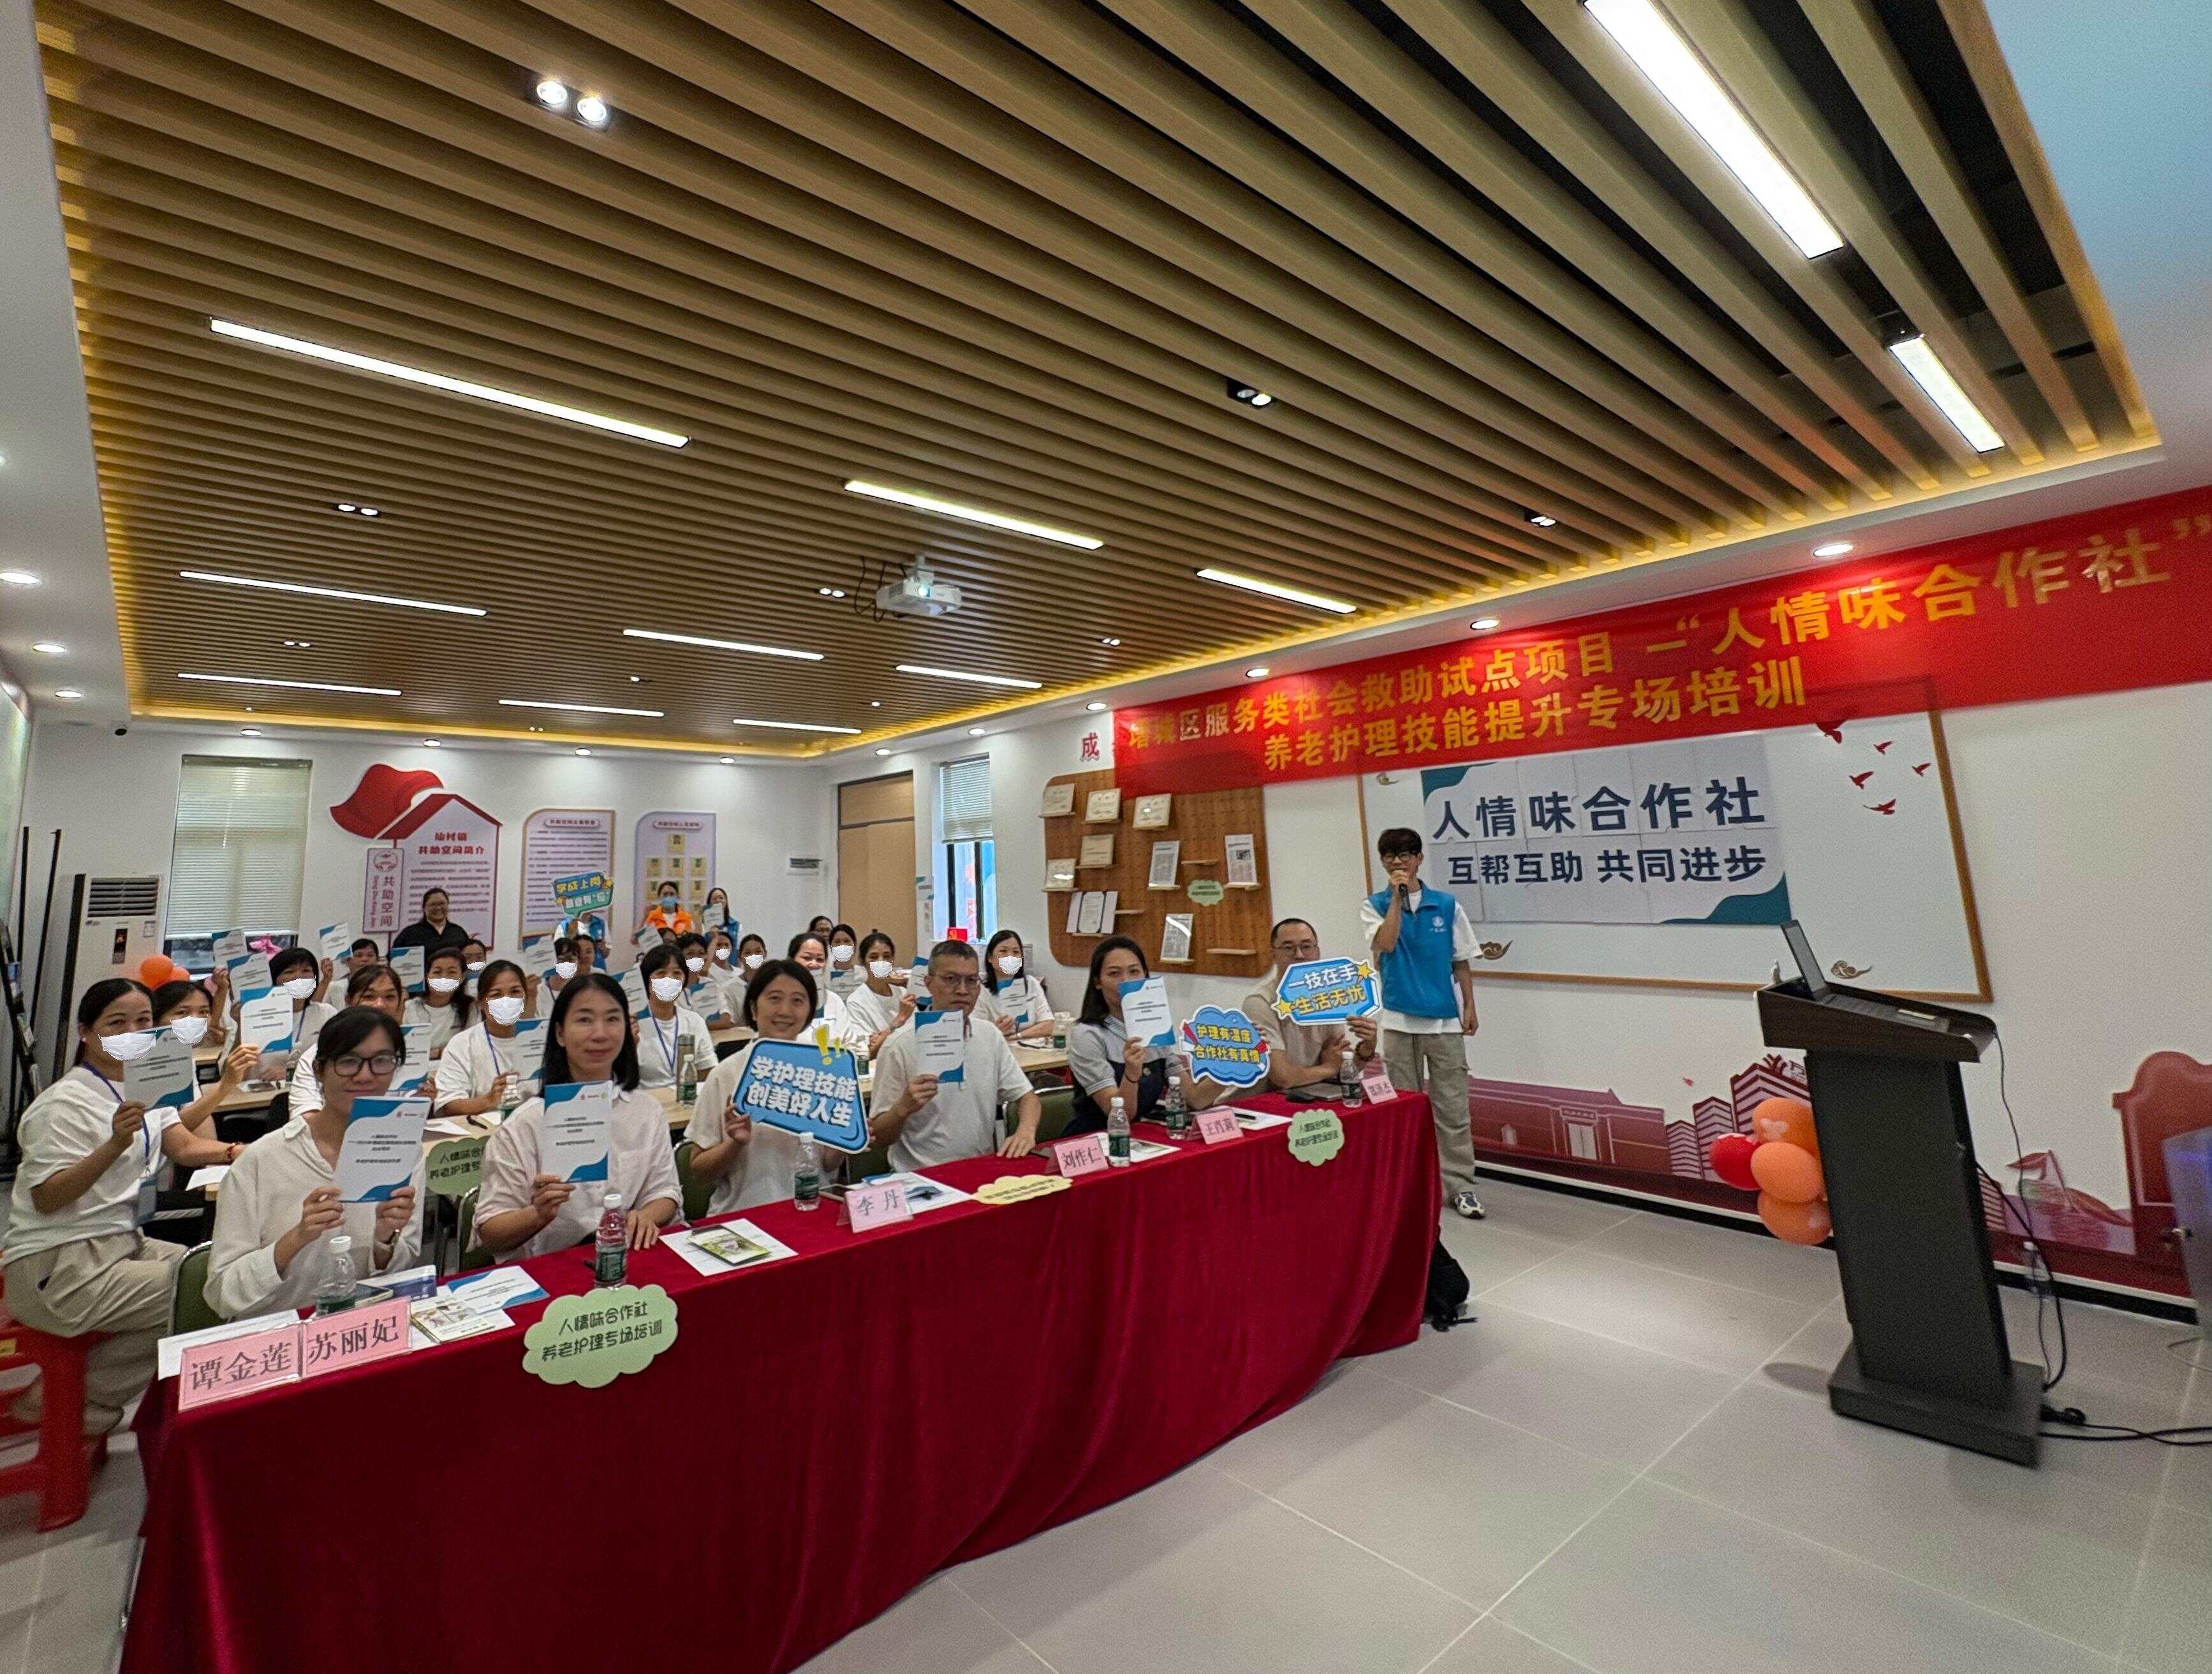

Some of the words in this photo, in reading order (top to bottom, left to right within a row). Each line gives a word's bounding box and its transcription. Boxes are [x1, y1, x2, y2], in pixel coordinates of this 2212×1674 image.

[1265, 656, 1806, 772] 养老护理技能提升专场培训
[1433, 776, 1766, 841] 人情味合作社
[1448, 850, 1583, 885] 互帮互助
[1596, 845, 1766, 884] 共同进步
[381, 876, 395, 927] 共助空间
[1288, 963, 1357, 990] 一技在手
[1295, 984, 1366, 1014] 生活无忧
[1197, 1025, 1251, 1044] 护理有温度
[751, 1055, 857, 1102] 学护理技能
[746, 1081, 853, 1128] 创美好人生
[1061, 1147, 1102, 1170] 刘作仁
[308, 1315, 400, 1365] 苏丽妃
[542, 1319, 663, 1363] 养老护理专场培训
[558, 1301, 648, 1337] 人情味合作社
[192, 1342, 292, 1390] 谭金莲
